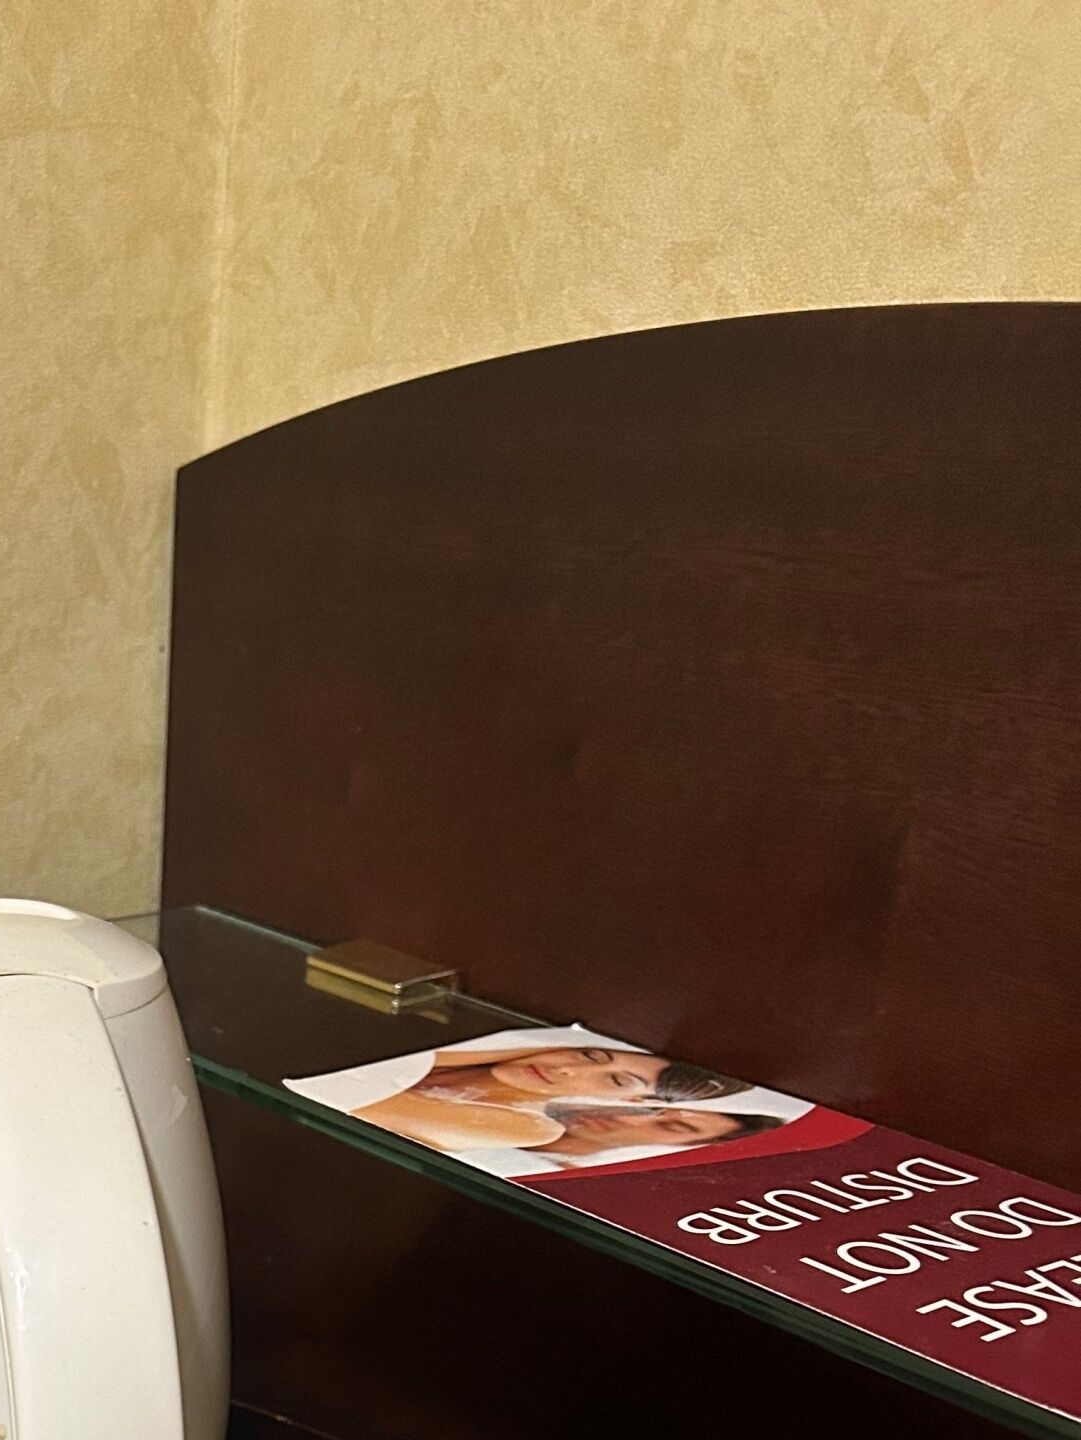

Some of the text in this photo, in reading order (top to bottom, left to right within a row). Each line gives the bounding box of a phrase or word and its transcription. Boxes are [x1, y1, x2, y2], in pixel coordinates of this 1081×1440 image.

[677, 1157, 980, 1245] DISTURB
[799, 1197, 1081, 1294] DO NOT
[915, 1254, 1081, 1343] EASE
